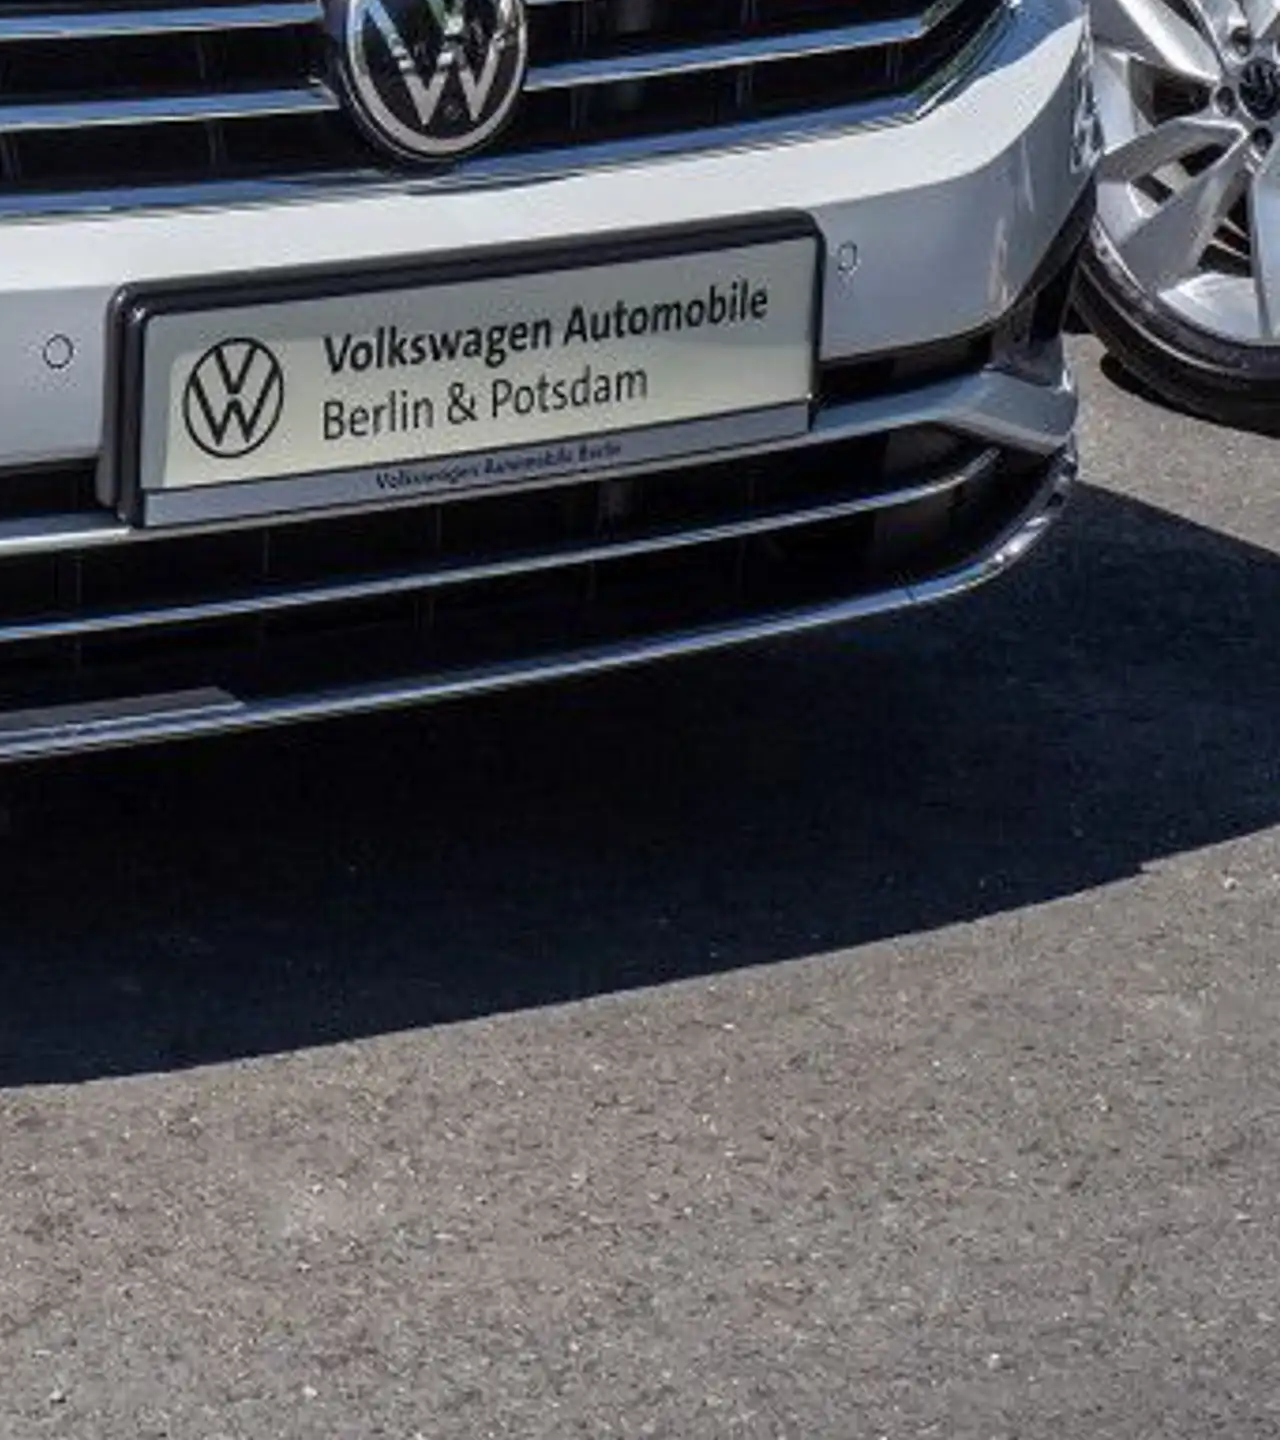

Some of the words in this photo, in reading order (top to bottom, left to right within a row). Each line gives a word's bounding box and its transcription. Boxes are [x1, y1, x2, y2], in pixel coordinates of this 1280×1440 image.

[323, 316, 552, 375] Volkswagen
[562, 276, 769, 346] Automobile
[322, 389, 435, 441] Berlin
[446, 381, 478, 425] &
[490, 364, 648, 419] Potsdam
